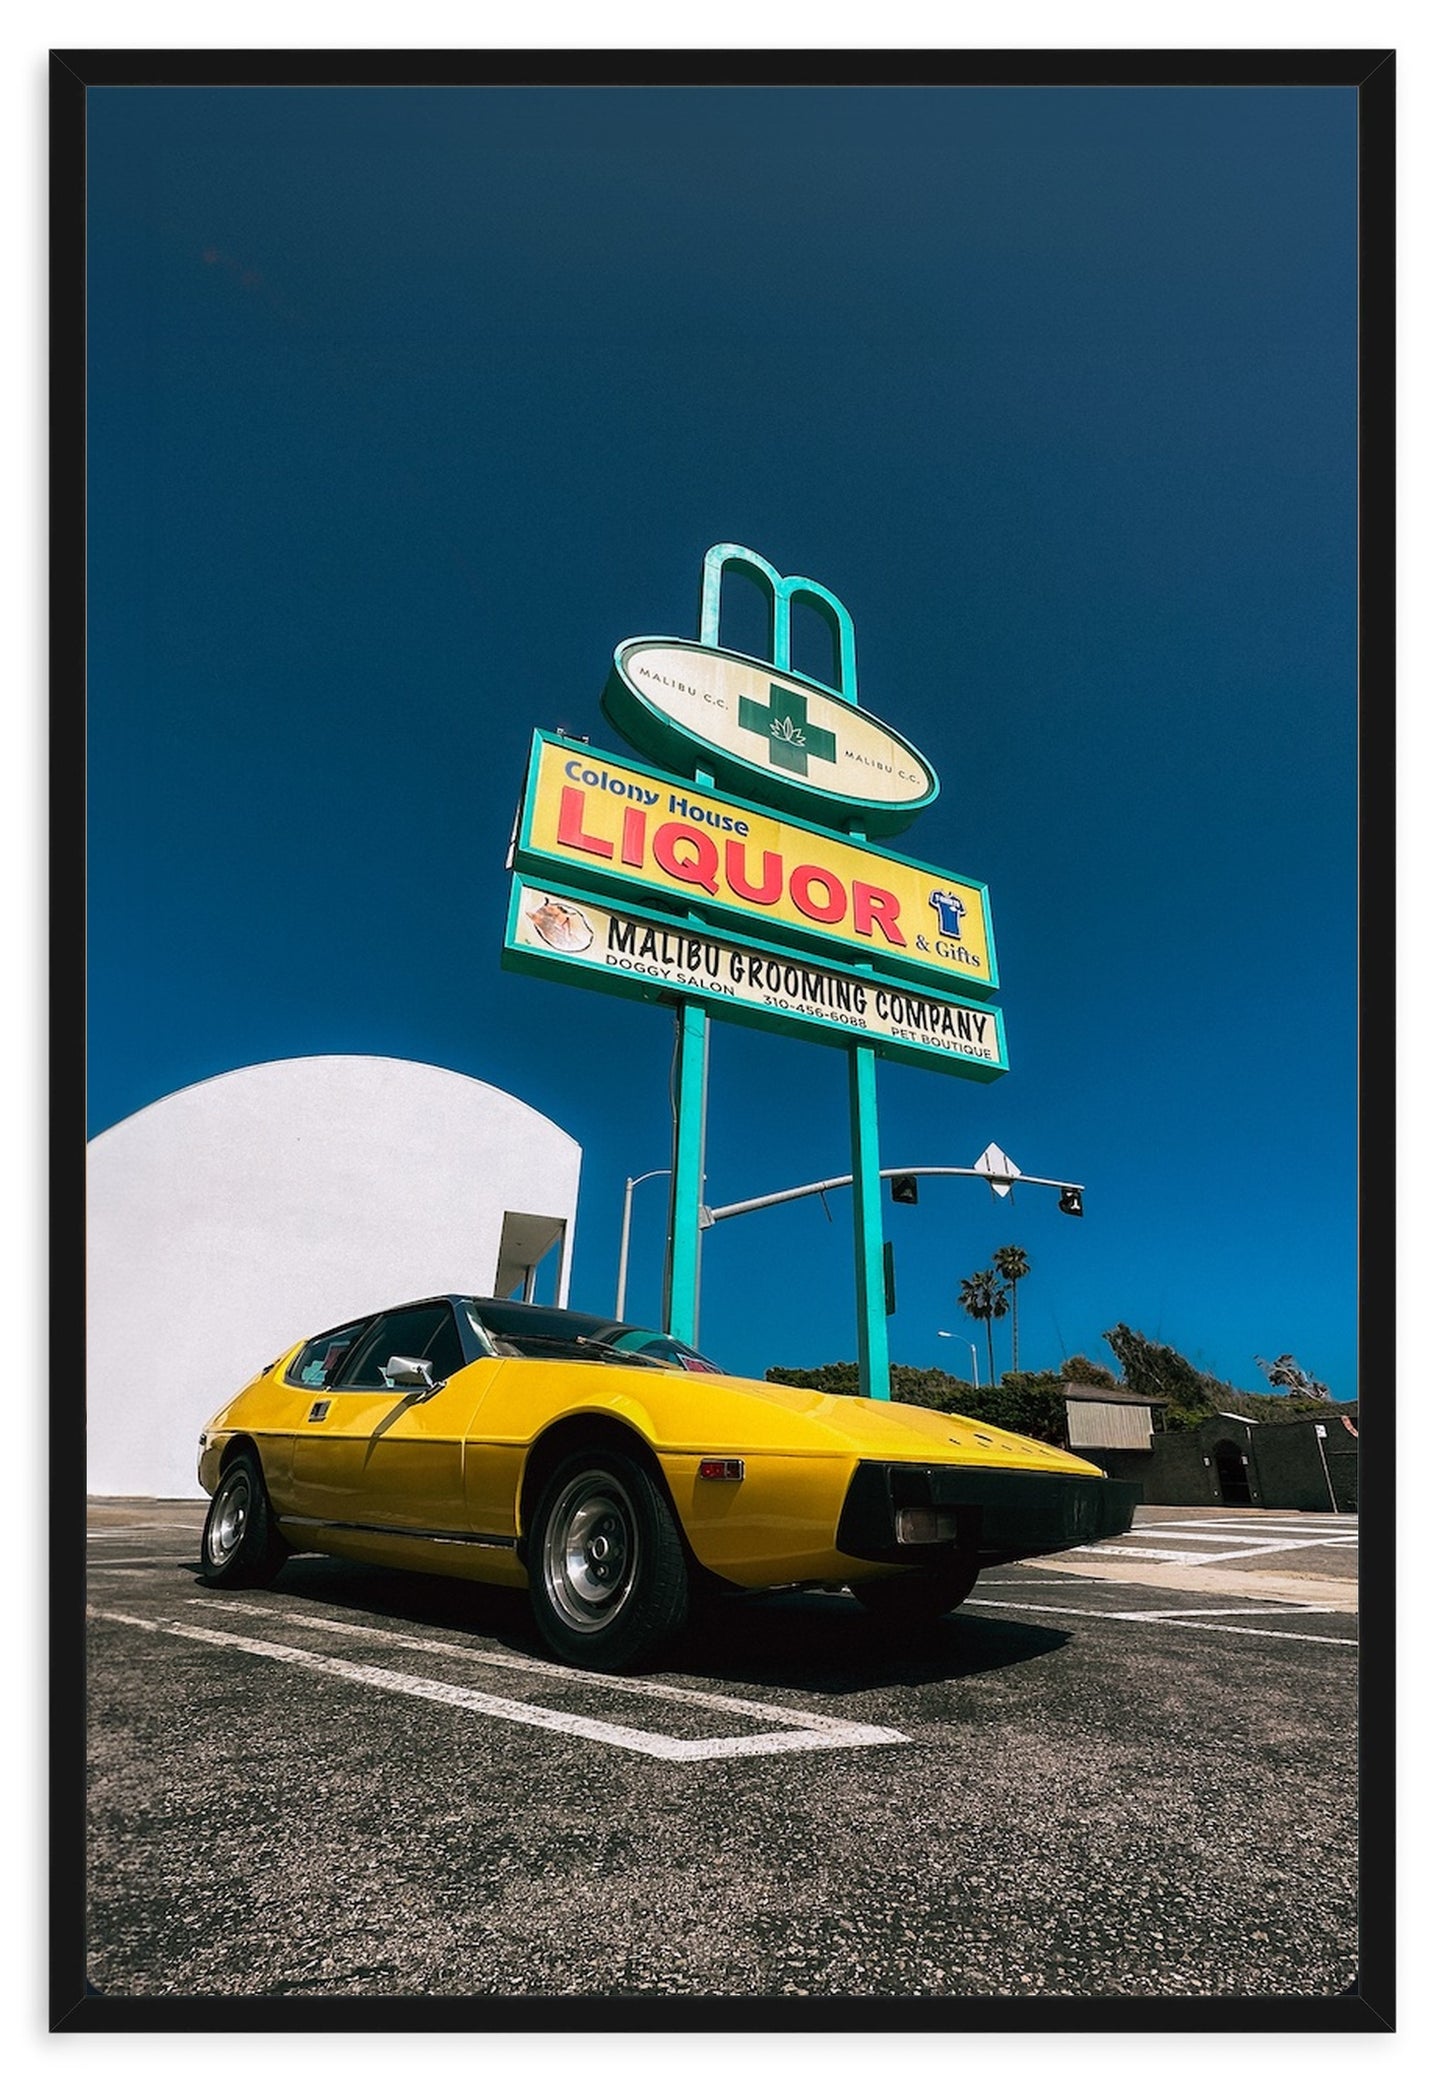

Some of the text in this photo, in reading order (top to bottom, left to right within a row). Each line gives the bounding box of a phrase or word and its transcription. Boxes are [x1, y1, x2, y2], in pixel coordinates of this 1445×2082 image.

[639, 667, 697, 696] MALIBU
[844, 750, 893, 774] MALIBU
[564, 760, 750, 837] Colony House
[556, 785, 907, 947] LIQUOR
[915, 934, 981, 968] & Gifts
[605, 954, 735, 997] DOGGY SALON
[607, 915, 987, 1044] MALIBU GROOMING COMPANY
[763, 994, 868, 1029] 310-456-6088
[890, 1026, 993, 1061] PET BOUTIQUE
